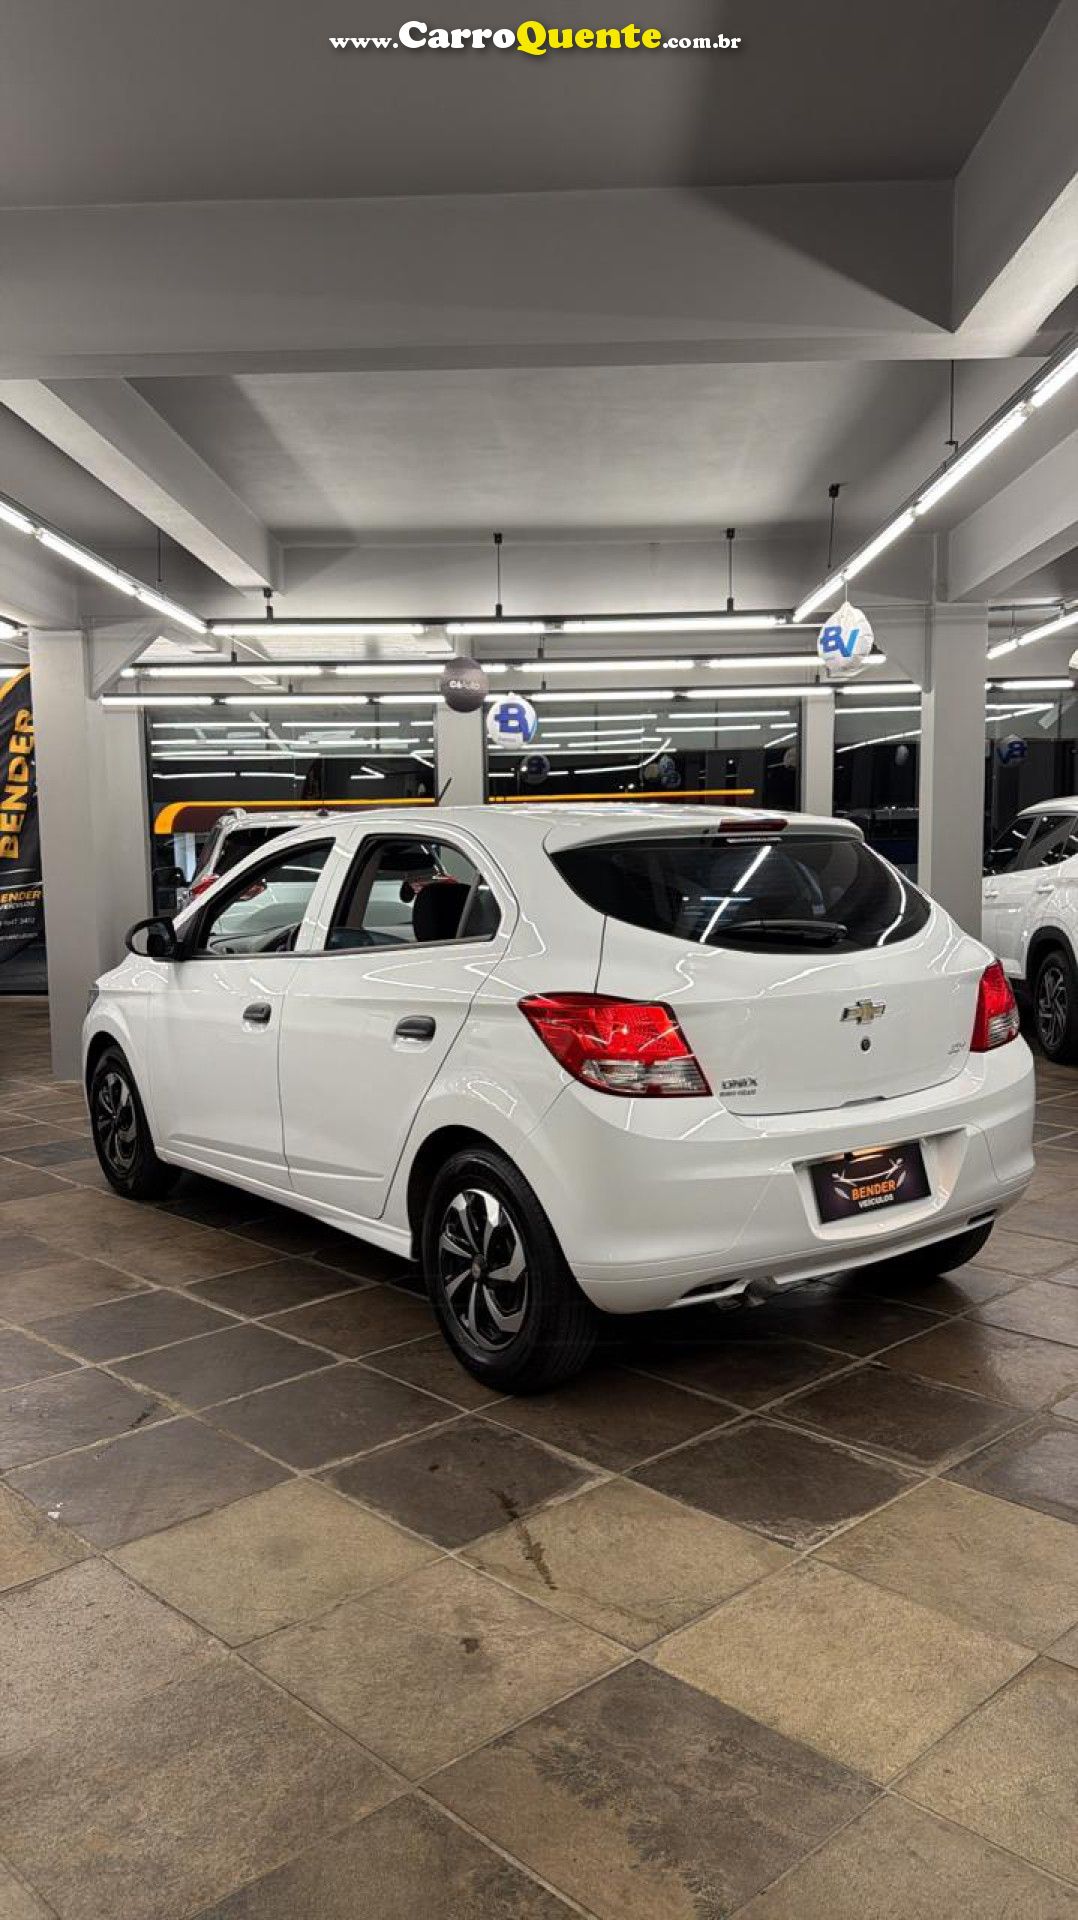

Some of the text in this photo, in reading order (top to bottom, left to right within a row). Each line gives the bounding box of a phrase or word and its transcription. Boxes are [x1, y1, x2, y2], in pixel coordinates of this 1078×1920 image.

[820, 626, 859, 657] BV
[0, 709, 34, 859] BENDER
[0, 890, 41, 903] ENDER
[852, 1180, 896, 1200] BENDER
